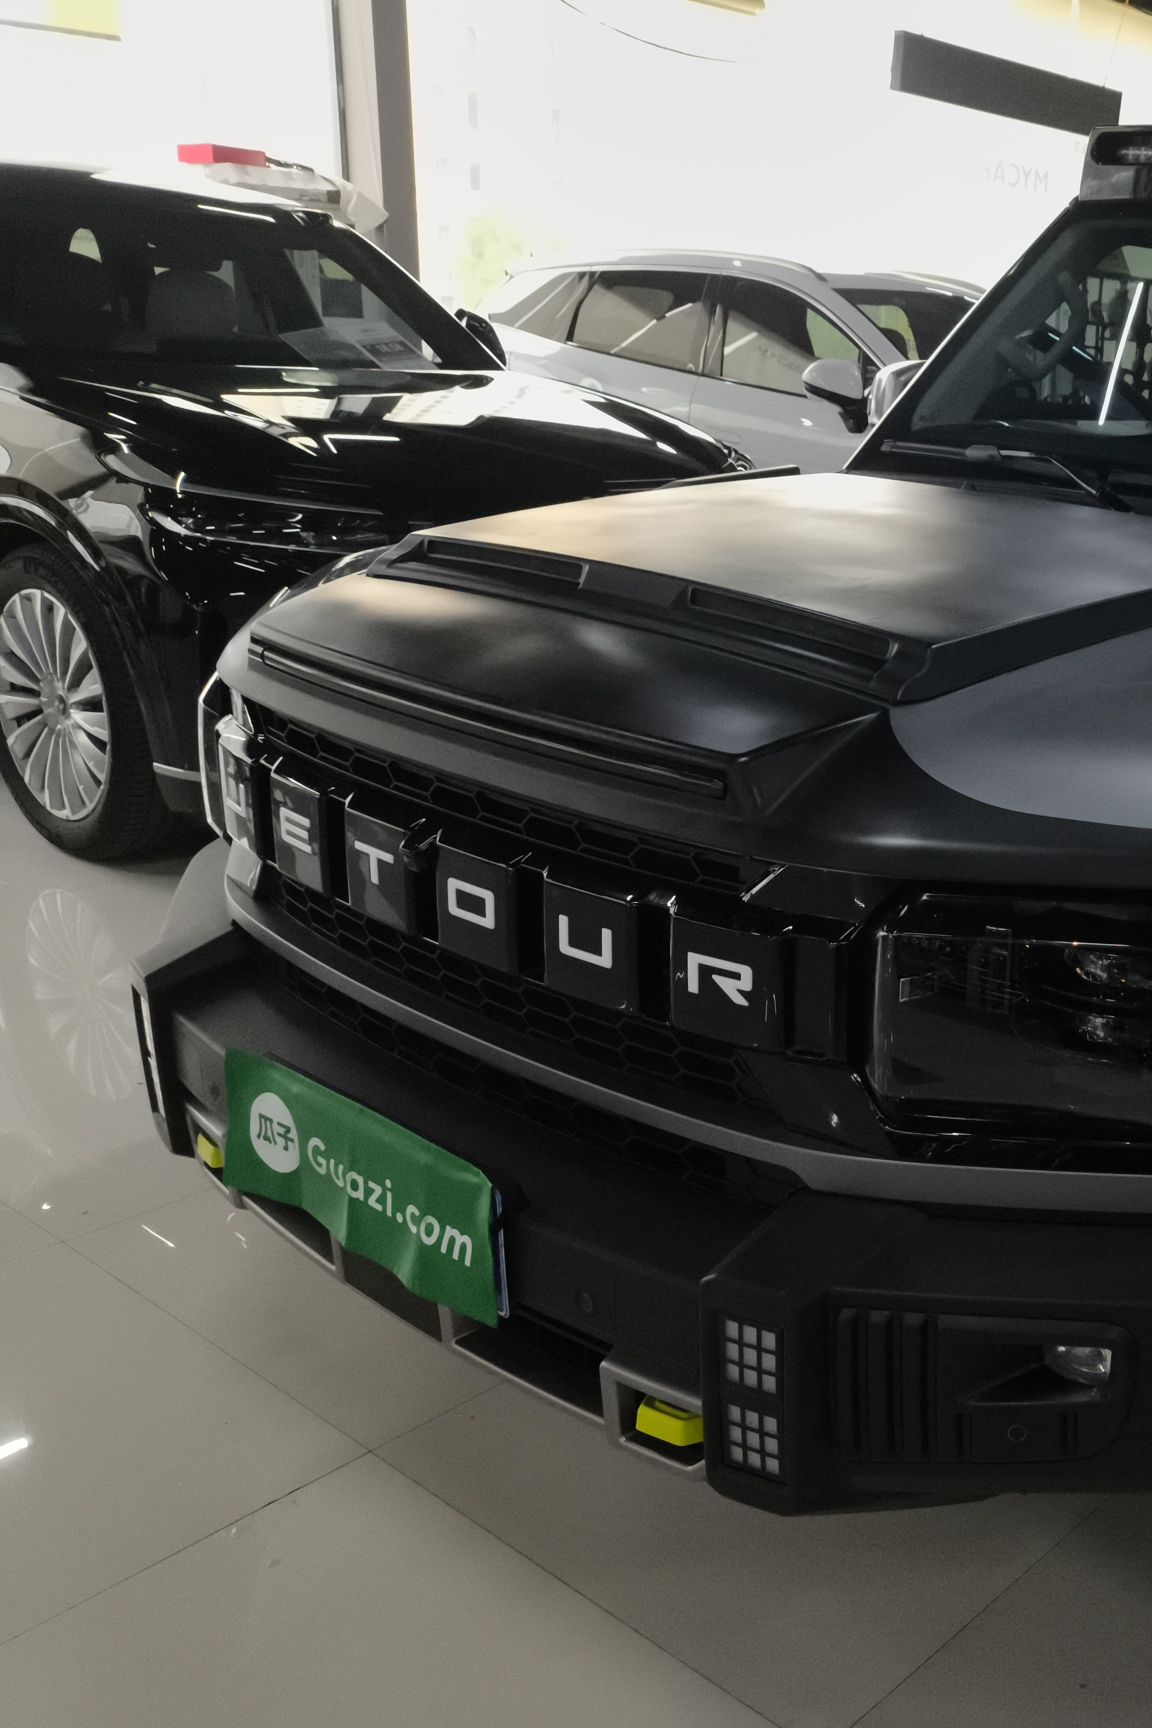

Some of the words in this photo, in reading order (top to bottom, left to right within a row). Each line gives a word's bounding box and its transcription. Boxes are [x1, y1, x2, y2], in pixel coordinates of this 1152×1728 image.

[226, 783, 752, 1006] JETOUR
[257, 1112, 295, 1152] 瓜子
[307, 1137, 473, 1267] Guazi.com
